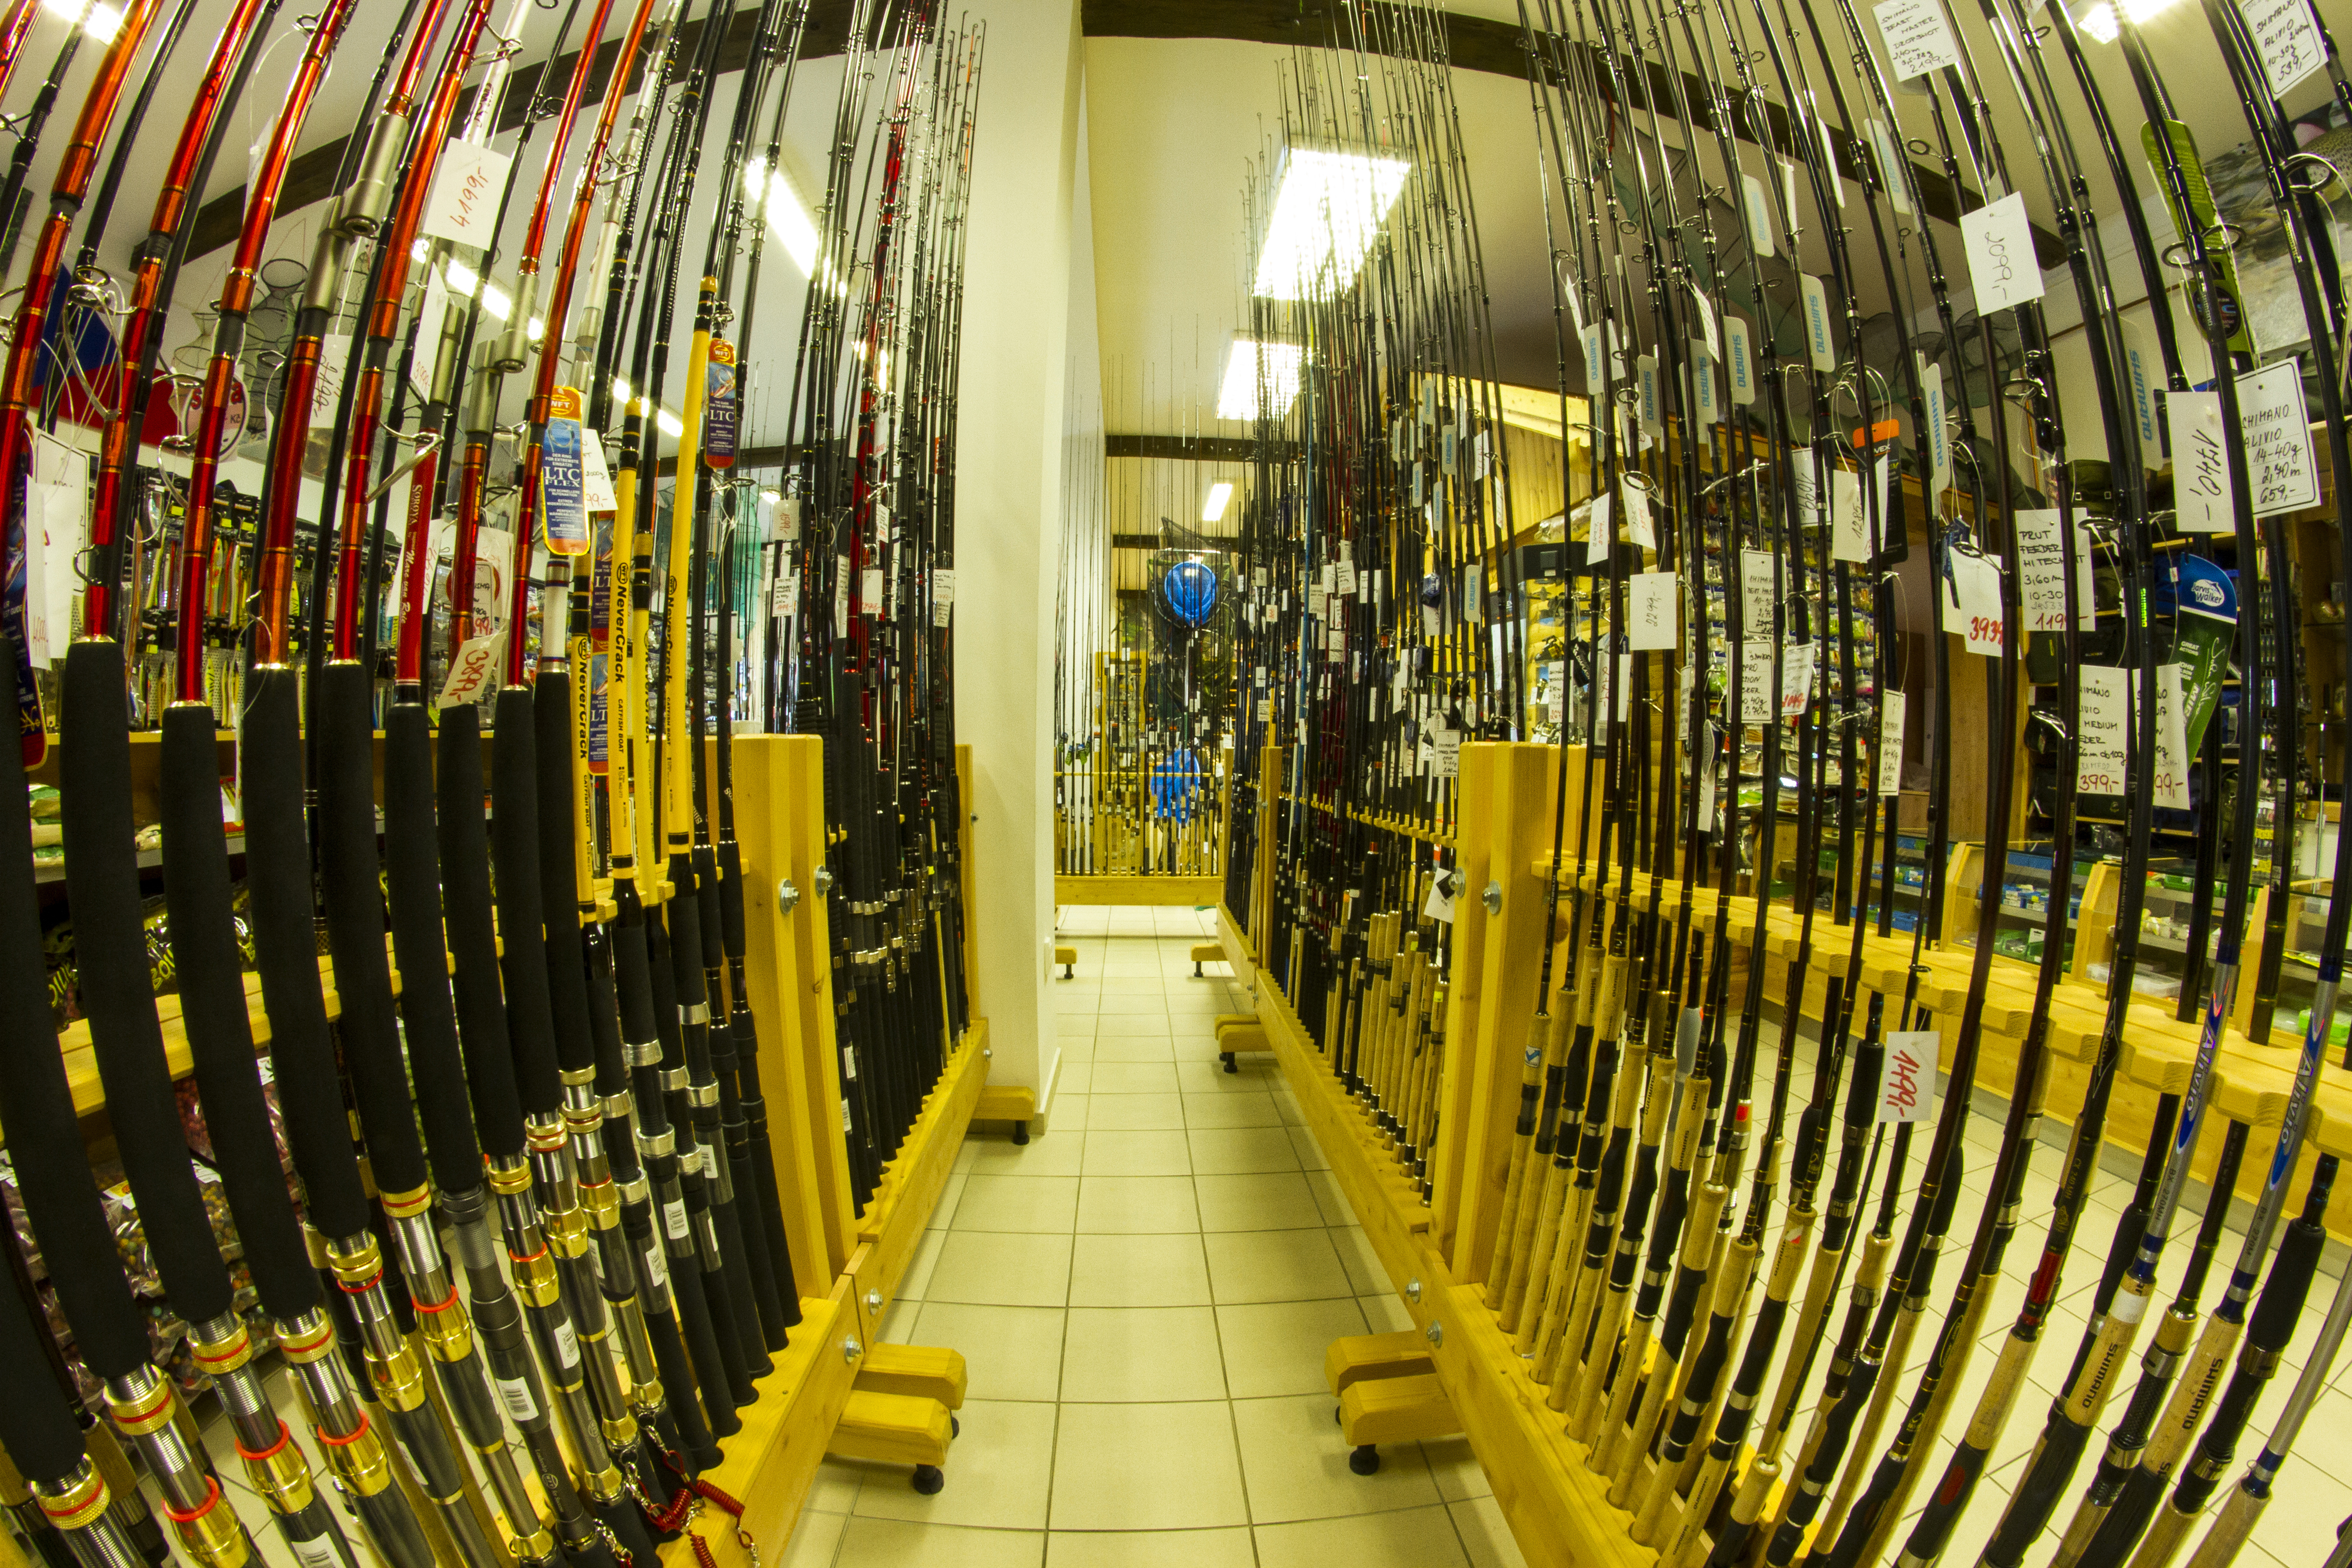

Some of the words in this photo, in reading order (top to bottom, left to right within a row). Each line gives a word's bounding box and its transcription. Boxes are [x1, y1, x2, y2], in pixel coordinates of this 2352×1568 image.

[1881, 4, 1920, 24] SHIMANO
[2264, 19, 2294, 49] ALIVIO
[1809, 295, 1826, 353] SHIMANO
[1732, 334, 1746, 388] SHIMANO
[1699, 356, 1710, 407] SHIMANO
[1644, 370, 1654, 421] SHIMANO
[2130, 349, 2153, 442] SHIMANO
[710, 410, 734, 422] LTC
[1931, 390, 1943, 467] SHIMANO
[2244, 428, 2282, 449] ALIVIO
[2253, 442, 2303, 463] 14-40g
[544, 466, 581, 482] LTC
[545, 478, 580, 487] FLEX
[2260, 484, 2296, 505] 659,-
[2019, 544, 2064, 554] FEEDER
[594, 576, 611, 589] LT
[617, 563, 628, 584] WFT
[2193, 584, 2210, 594] Jarvis
[2196, 591, 2222, 604] Walker
[614, 586, 627, 683] NeverCrack
[579, 662, 587, 759] NeverCrack
[590, 708, 609, 722] LT
[2084, 720, 2118, 731] MEDIUM
[2186, 1026, 2216, 1112] Alivio
[1886, 1049, 1920, 1117] 1499,-
[2281, 1052, 2314, 1145] Alivio
[2082, 1343, 2118, 1409] SHIMANO
[2182, 1358, 2223, 1430] SHIMANO
